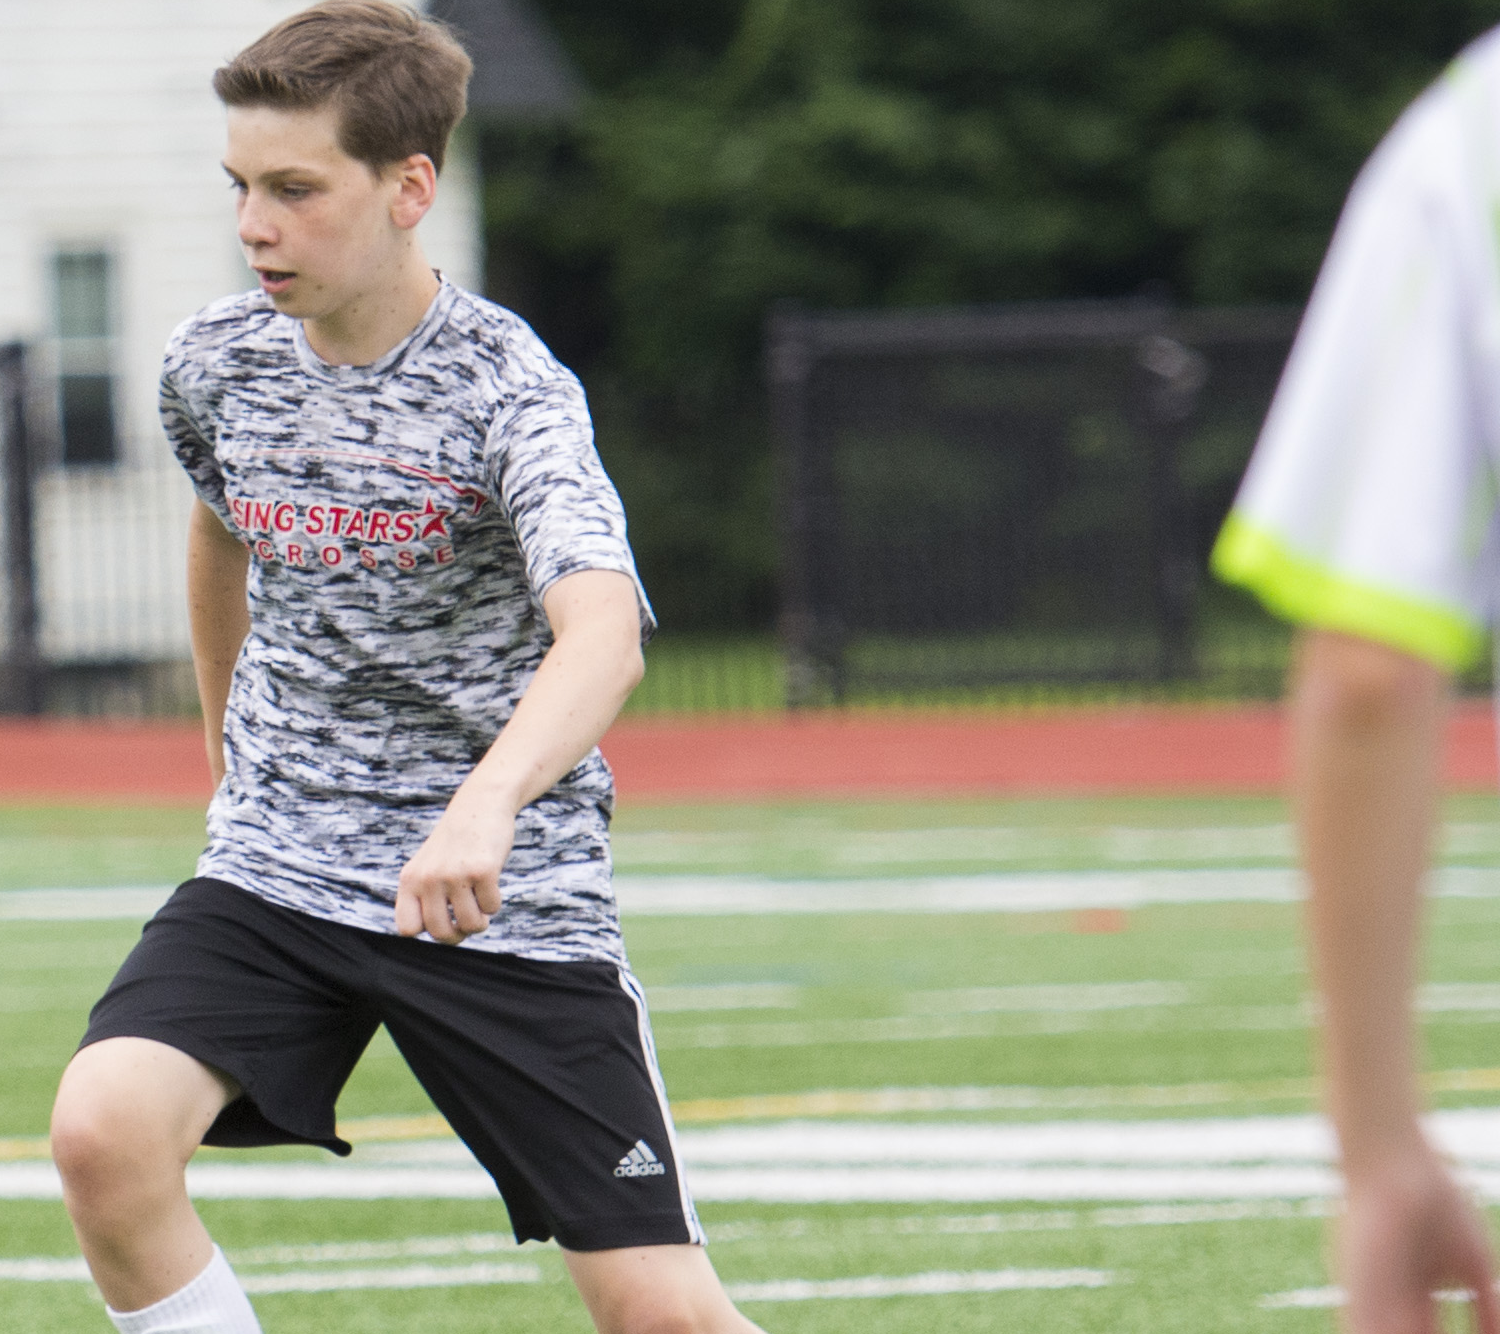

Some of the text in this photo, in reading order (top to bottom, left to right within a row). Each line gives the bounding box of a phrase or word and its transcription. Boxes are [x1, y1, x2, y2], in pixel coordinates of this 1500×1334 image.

[226, 496, 415, 543] SING STARS
[242, 537, 456, 569] CROSSE
